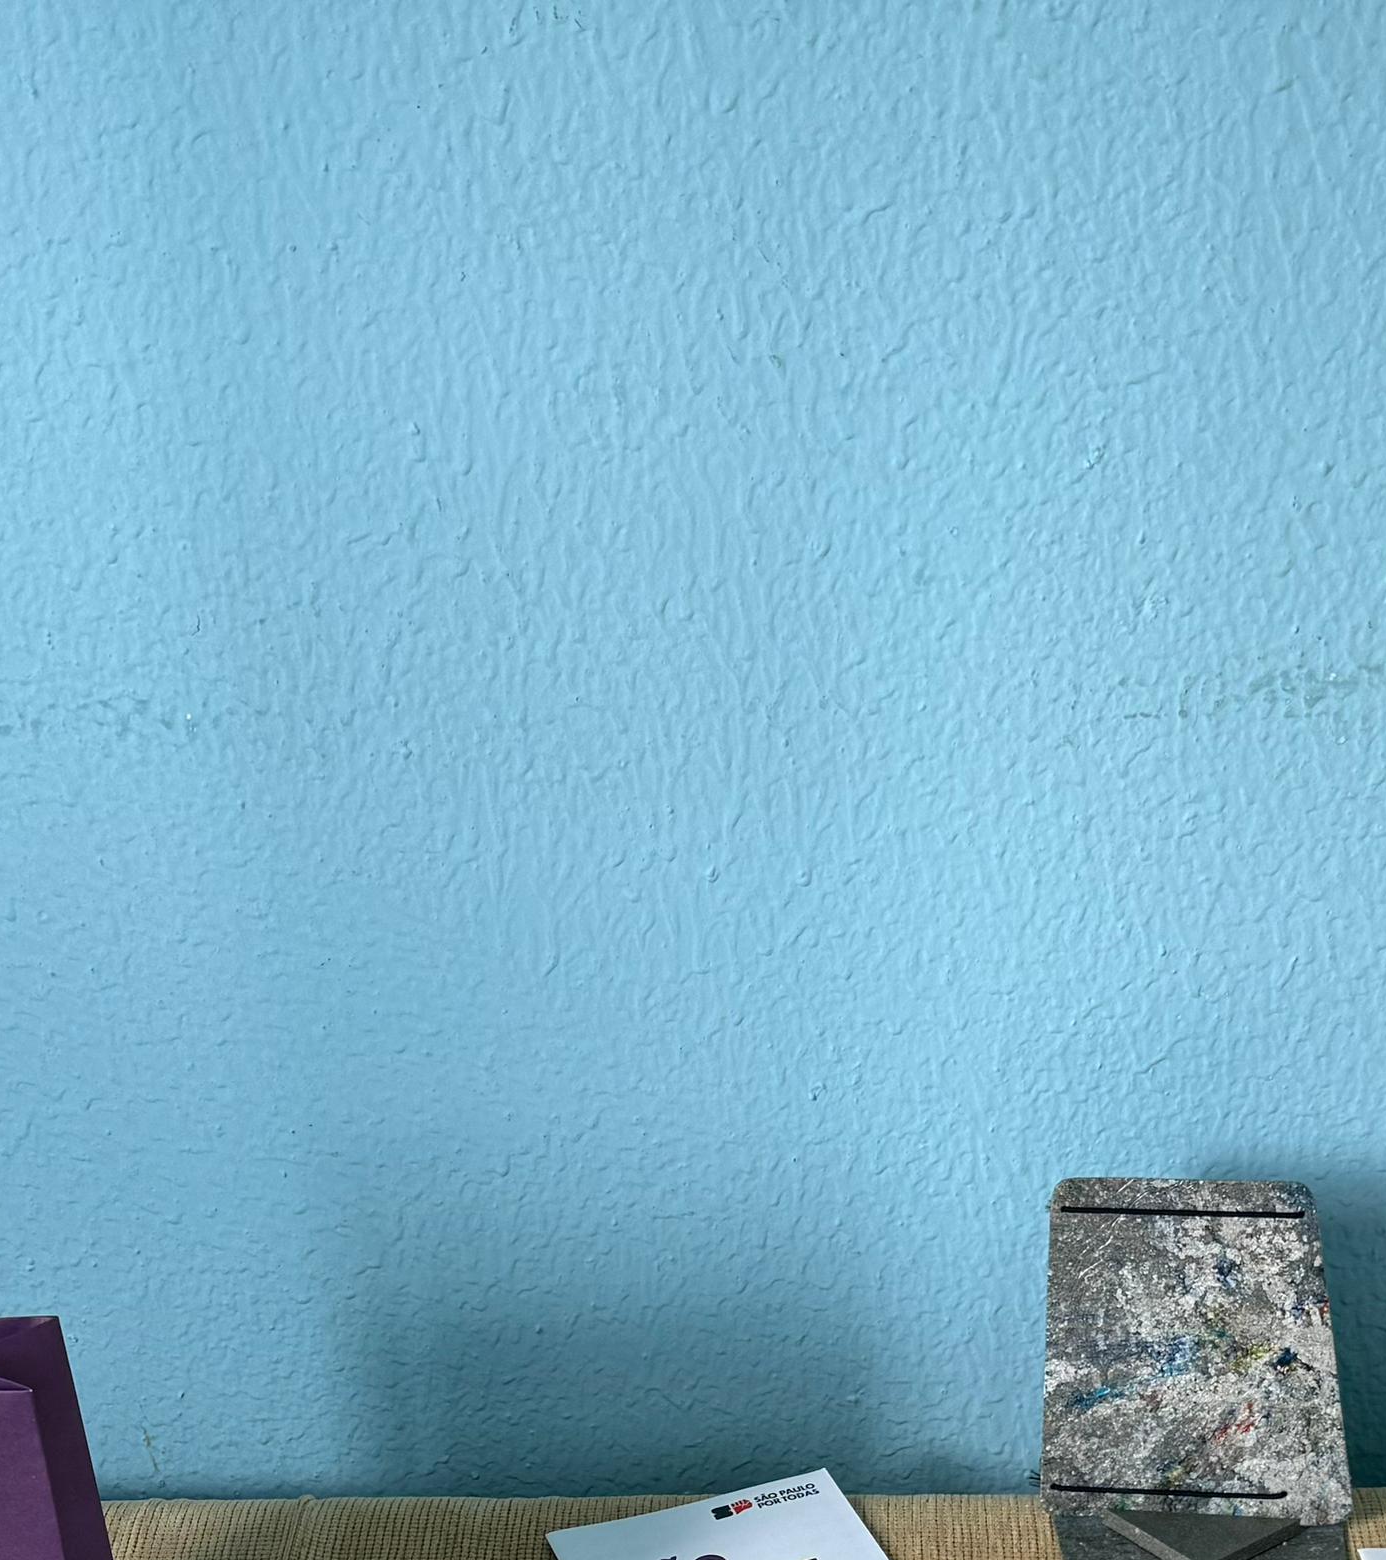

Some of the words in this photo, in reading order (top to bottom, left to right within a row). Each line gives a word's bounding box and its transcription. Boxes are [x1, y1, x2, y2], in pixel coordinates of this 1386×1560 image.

[754, 1492, 778, 1502] SÃO
[779, 1483, 815, 1496] PAULO
[756, 1496, 782, 1509] POR
[781, 1487, 820, 1502] TODAS
